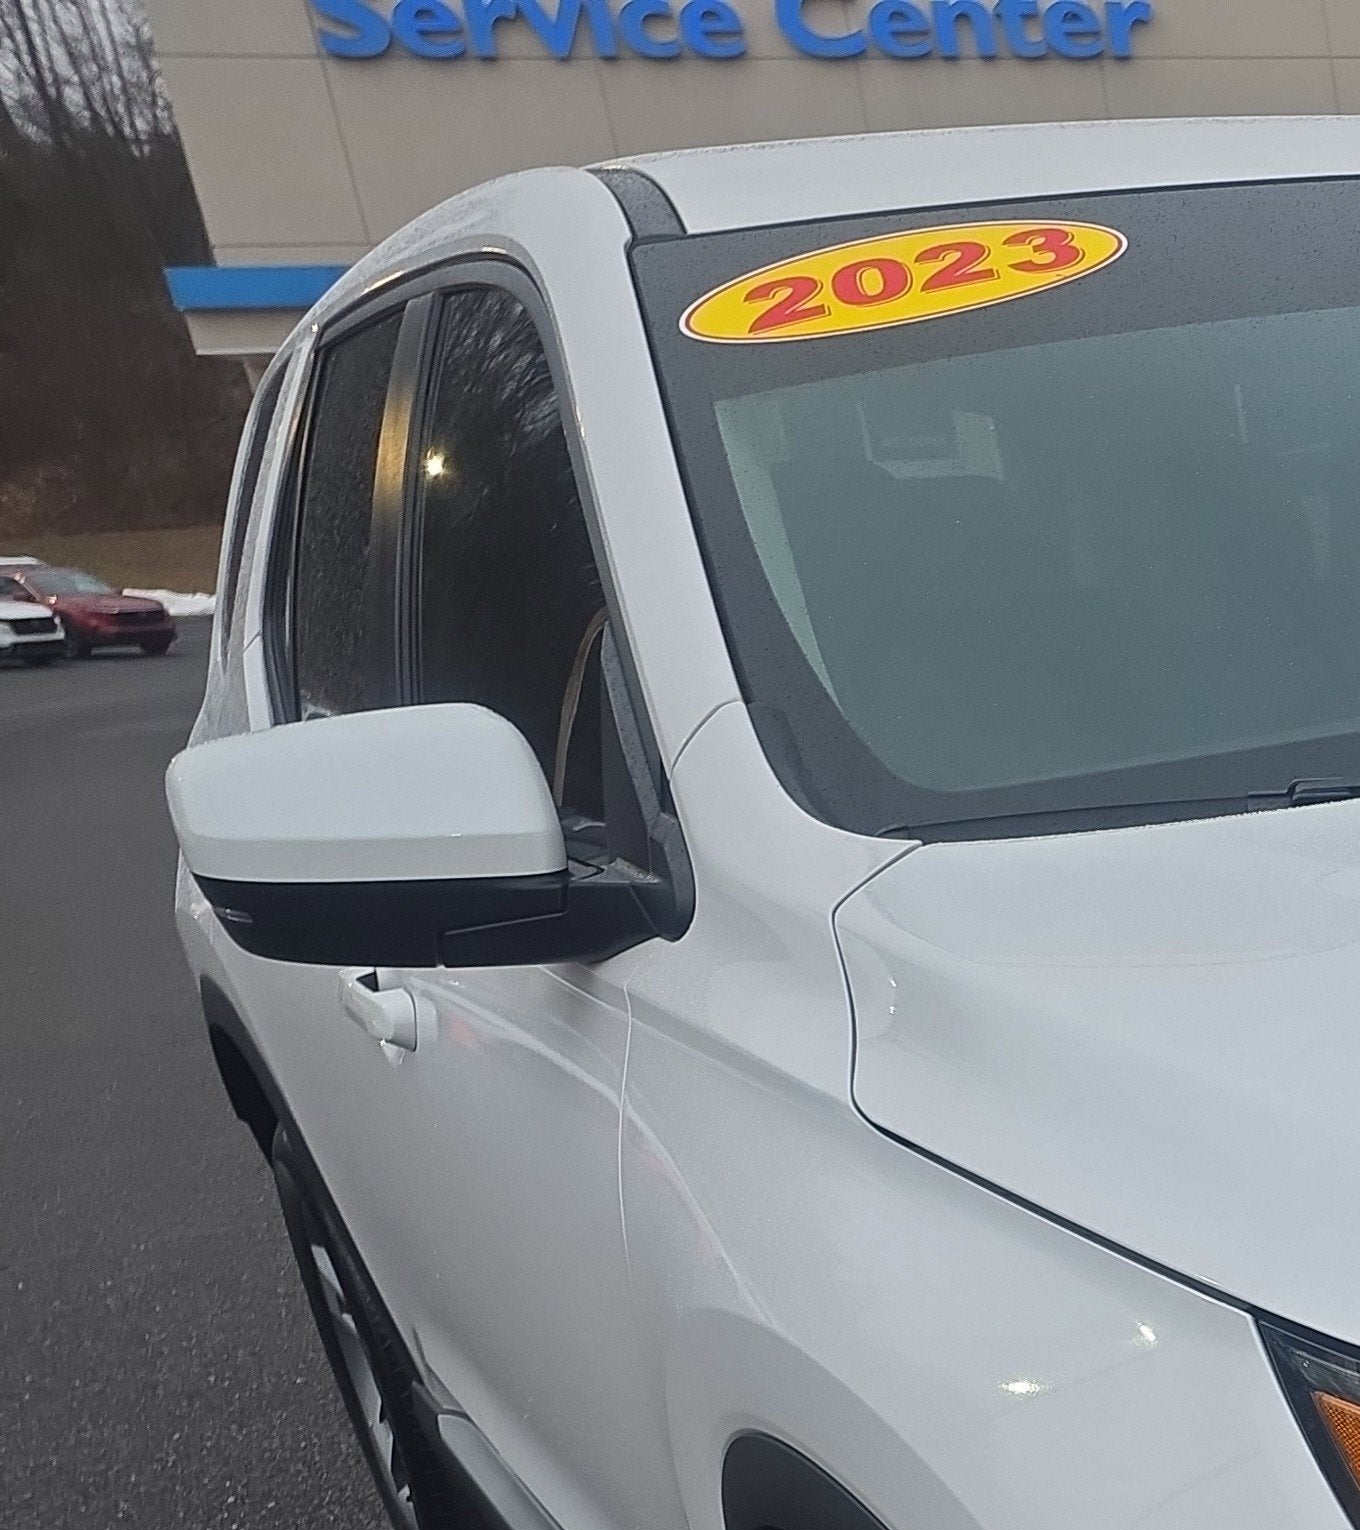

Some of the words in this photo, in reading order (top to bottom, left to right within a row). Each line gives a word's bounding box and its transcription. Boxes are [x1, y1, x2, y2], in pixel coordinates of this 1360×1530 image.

[315, 0, 745, 60] Service
[775, 0, 1151, 60] Center
[743, 228, 1086, 334] 2023
